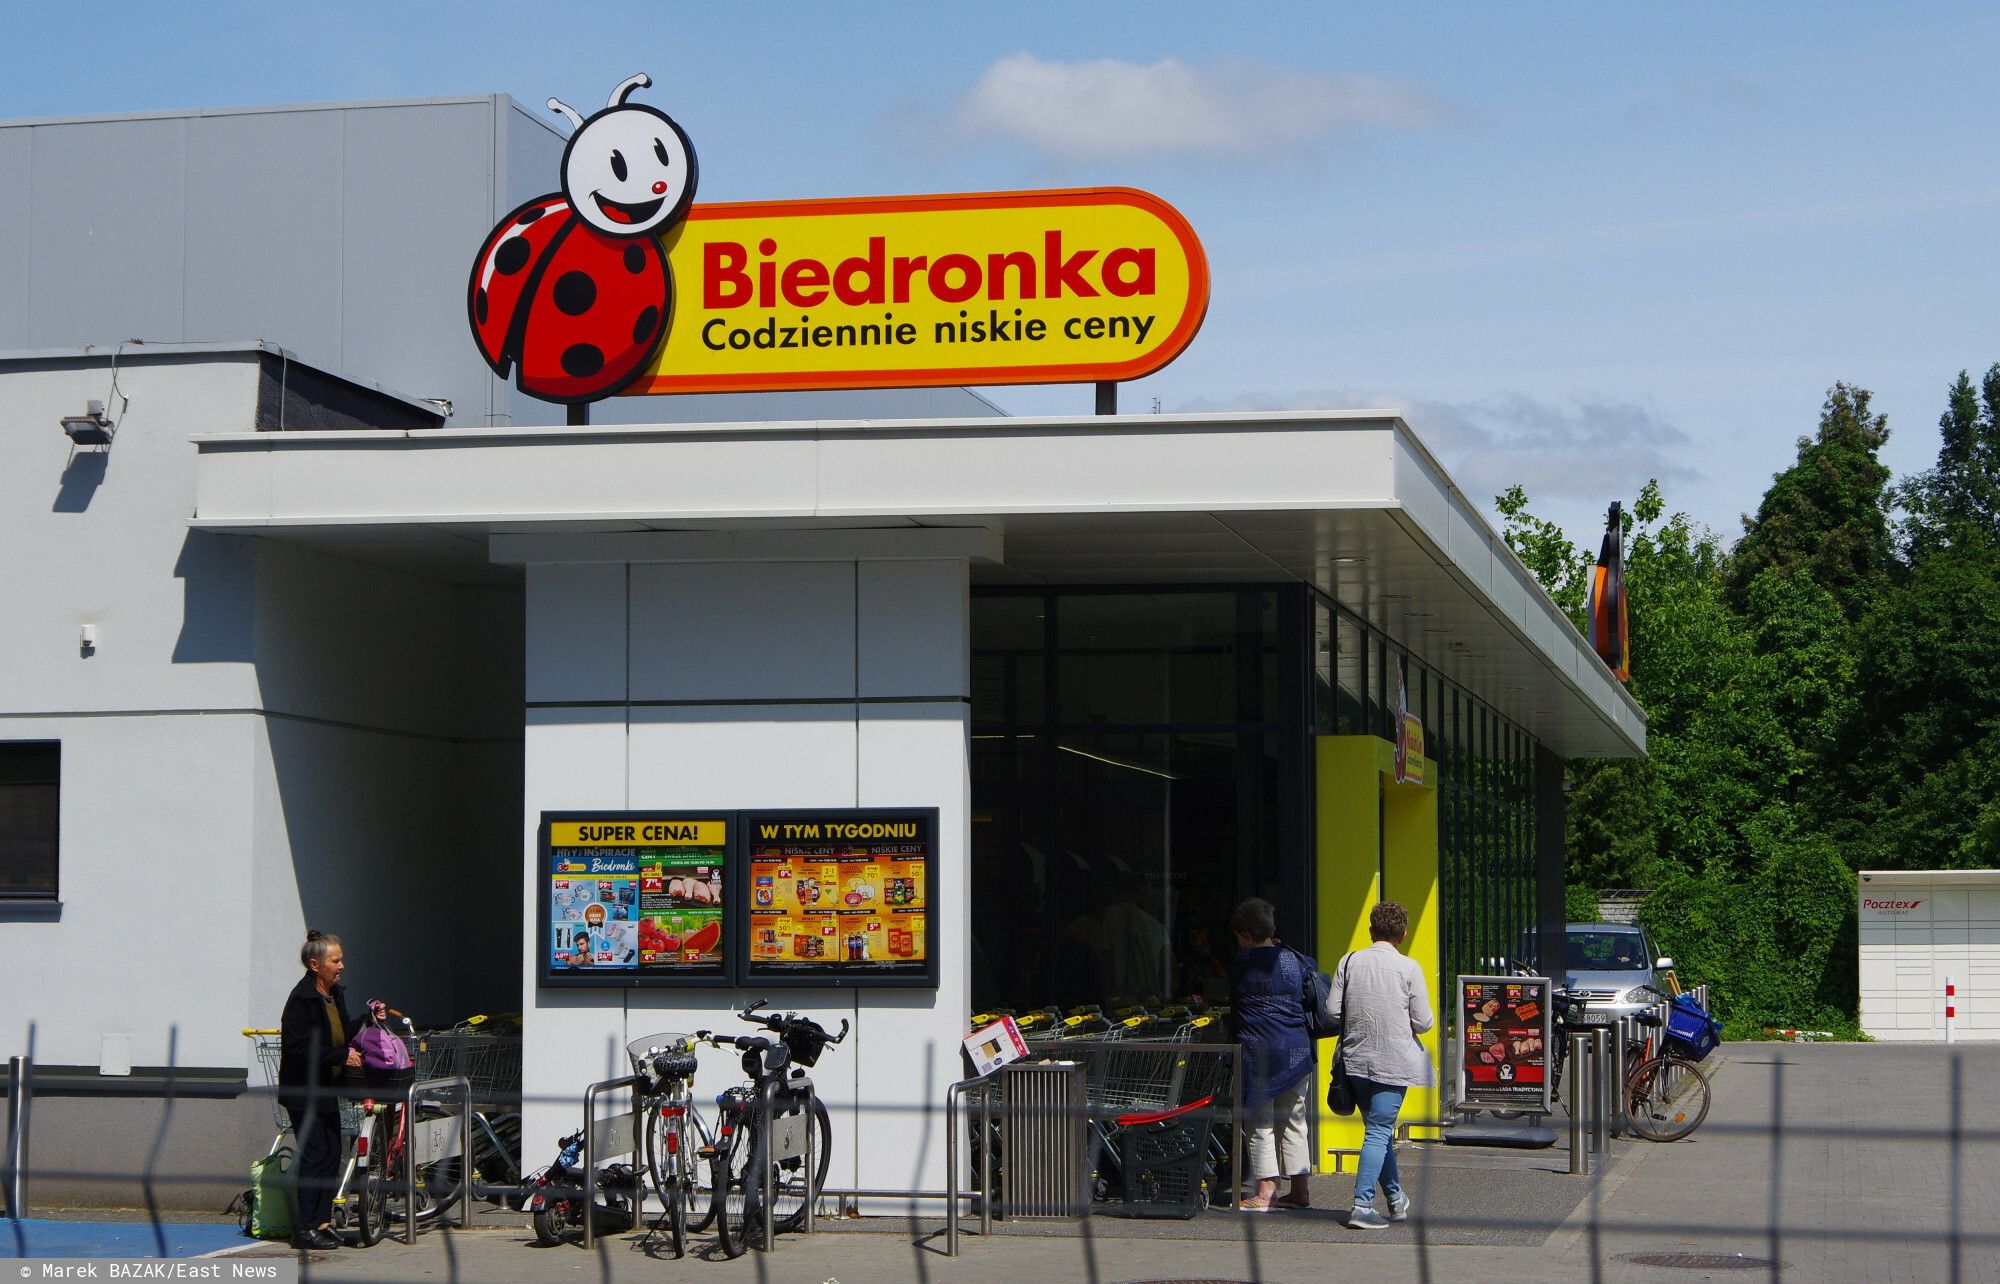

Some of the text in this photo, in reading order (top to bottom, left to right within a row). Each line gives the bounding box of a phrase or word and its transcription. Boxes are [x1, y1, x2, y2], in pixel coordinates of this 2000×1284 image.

[703, 230, 1157, 310] Biedronka
[701, 308, 1156, 351] Codziennie niskie ceny
[578, 825, 698, 841] SUPER CENA!
[760, 823, 917, 839] W TYM TYGODNIU
[900, 845, 922, 853] CENY
[591, 858, 635, 873] Biedronki
[1863, 899, 1910, 909] Pocztex
